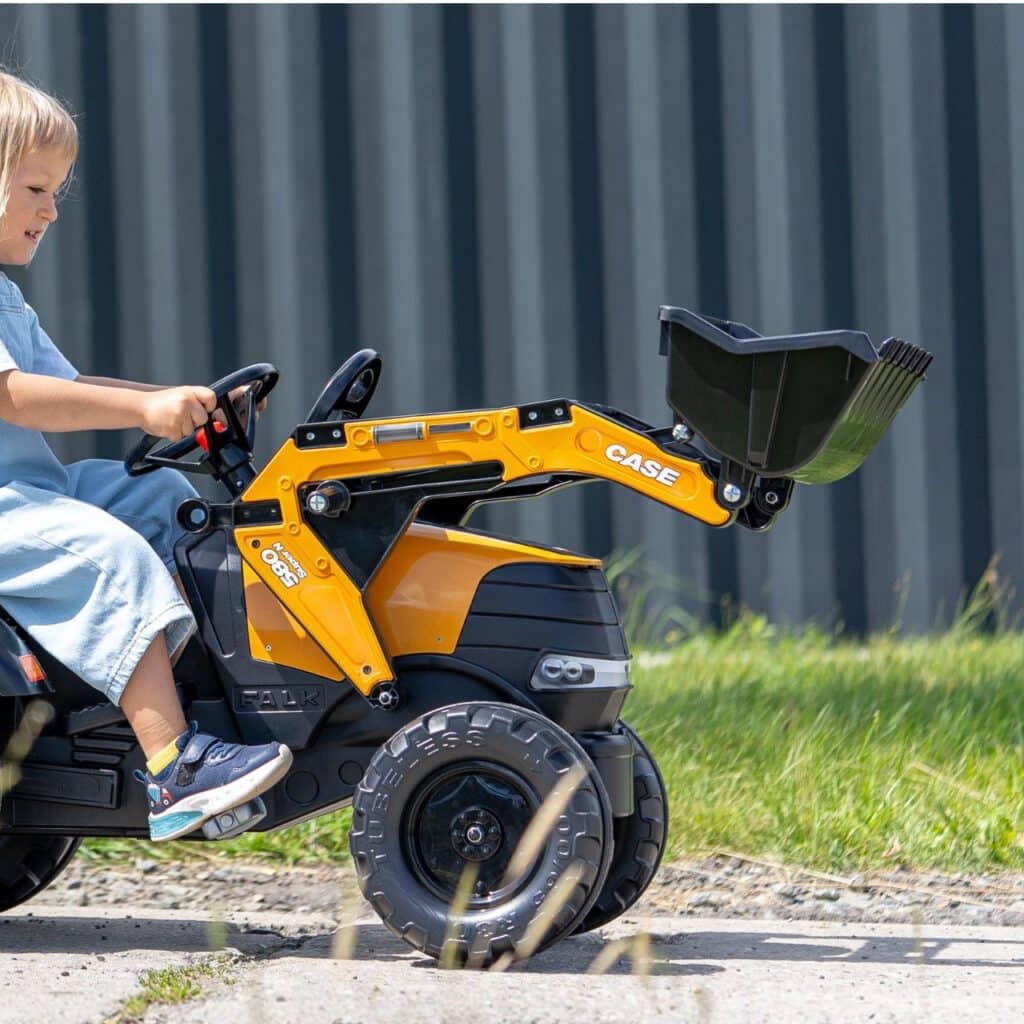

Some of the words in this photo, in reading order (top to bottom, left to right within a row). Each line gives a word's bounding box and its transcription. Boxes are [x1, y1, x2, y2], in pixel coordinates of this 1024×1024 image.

[605, 443, 681, 487] CASE
[261, 548, 299, 587] 580
[239, 689, 321, 708] FALK
